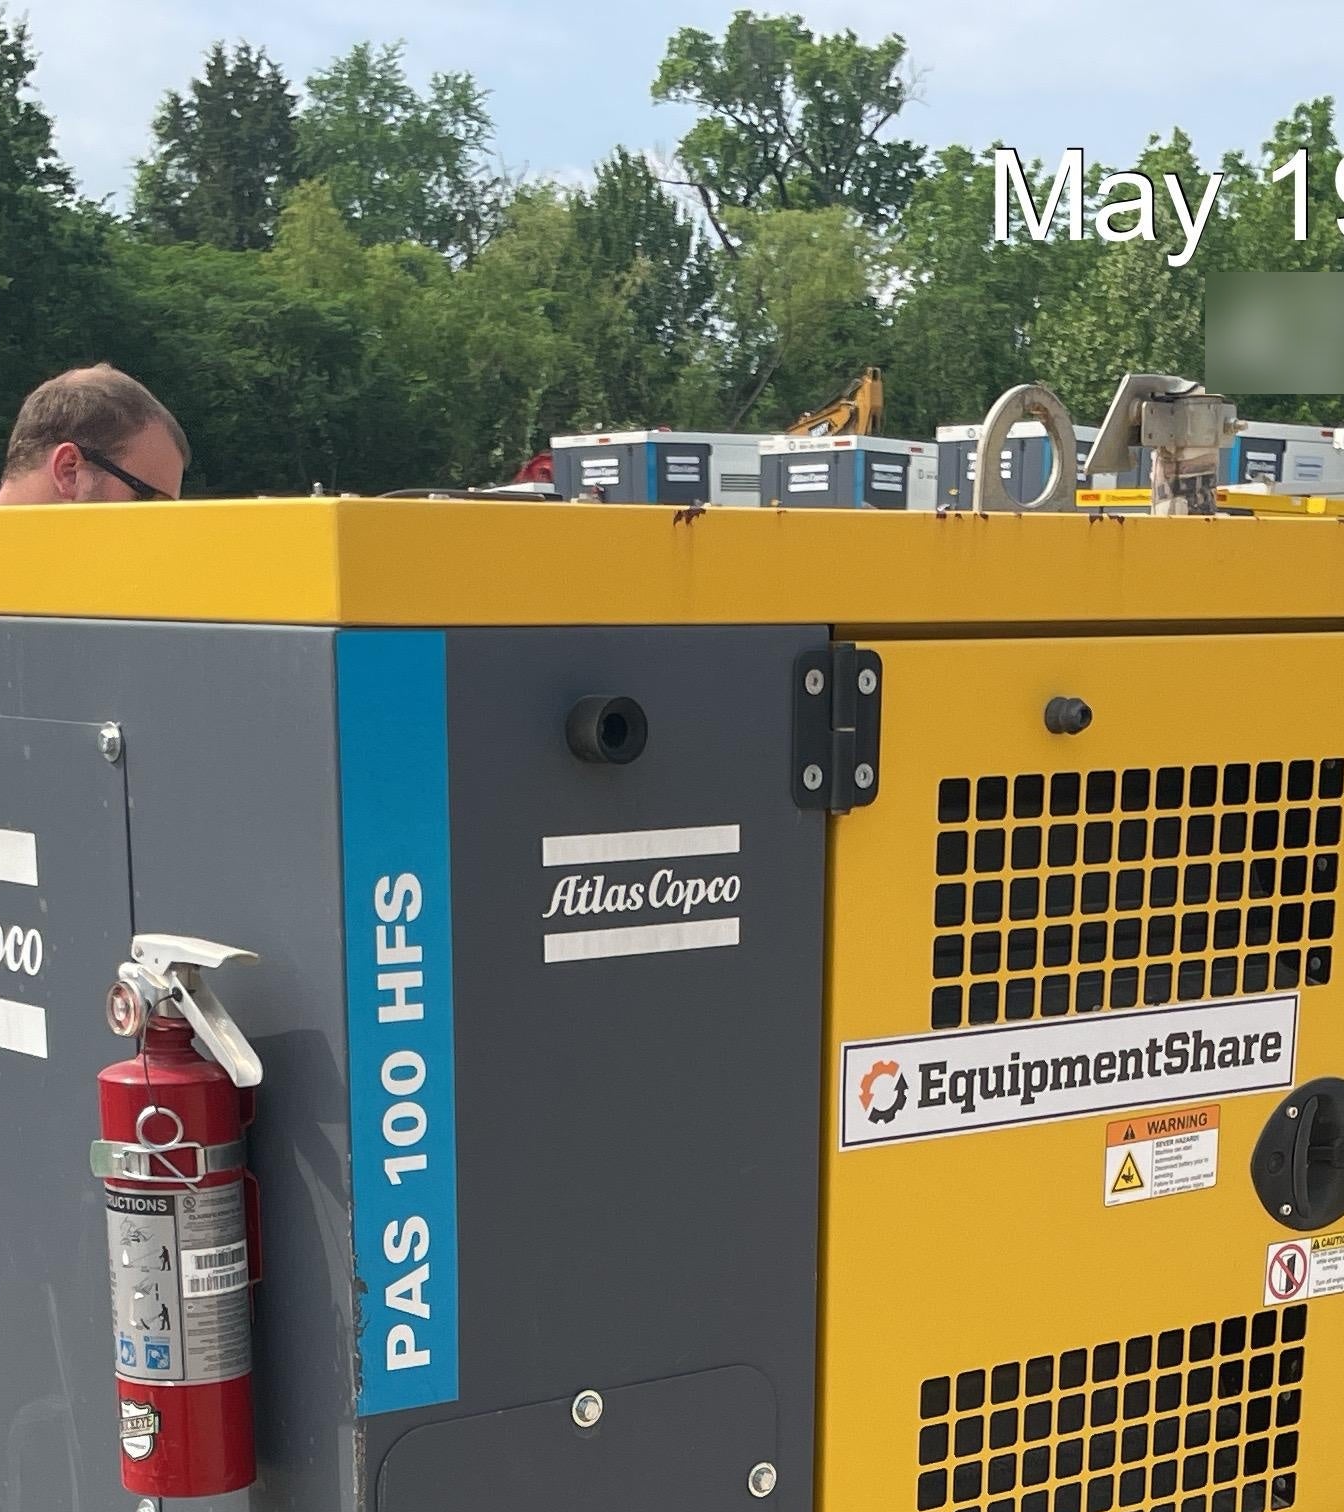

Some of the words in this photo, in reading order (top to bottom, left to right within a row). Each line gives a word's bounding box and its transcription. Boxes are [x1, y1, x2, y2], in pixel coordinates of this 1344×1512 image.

[374, 873, 424, 1023] HFS
[542, 875, 644, 918] Atlas
[648, 869, 741, 914] Copco
[381, 1050, 428, 1185] 100
[918, 1030, 1282, 1114] EquipmentShare
[1147, 1112, 1208, 1135] WARNING
[383, 1215, 431, 1371] PAS
